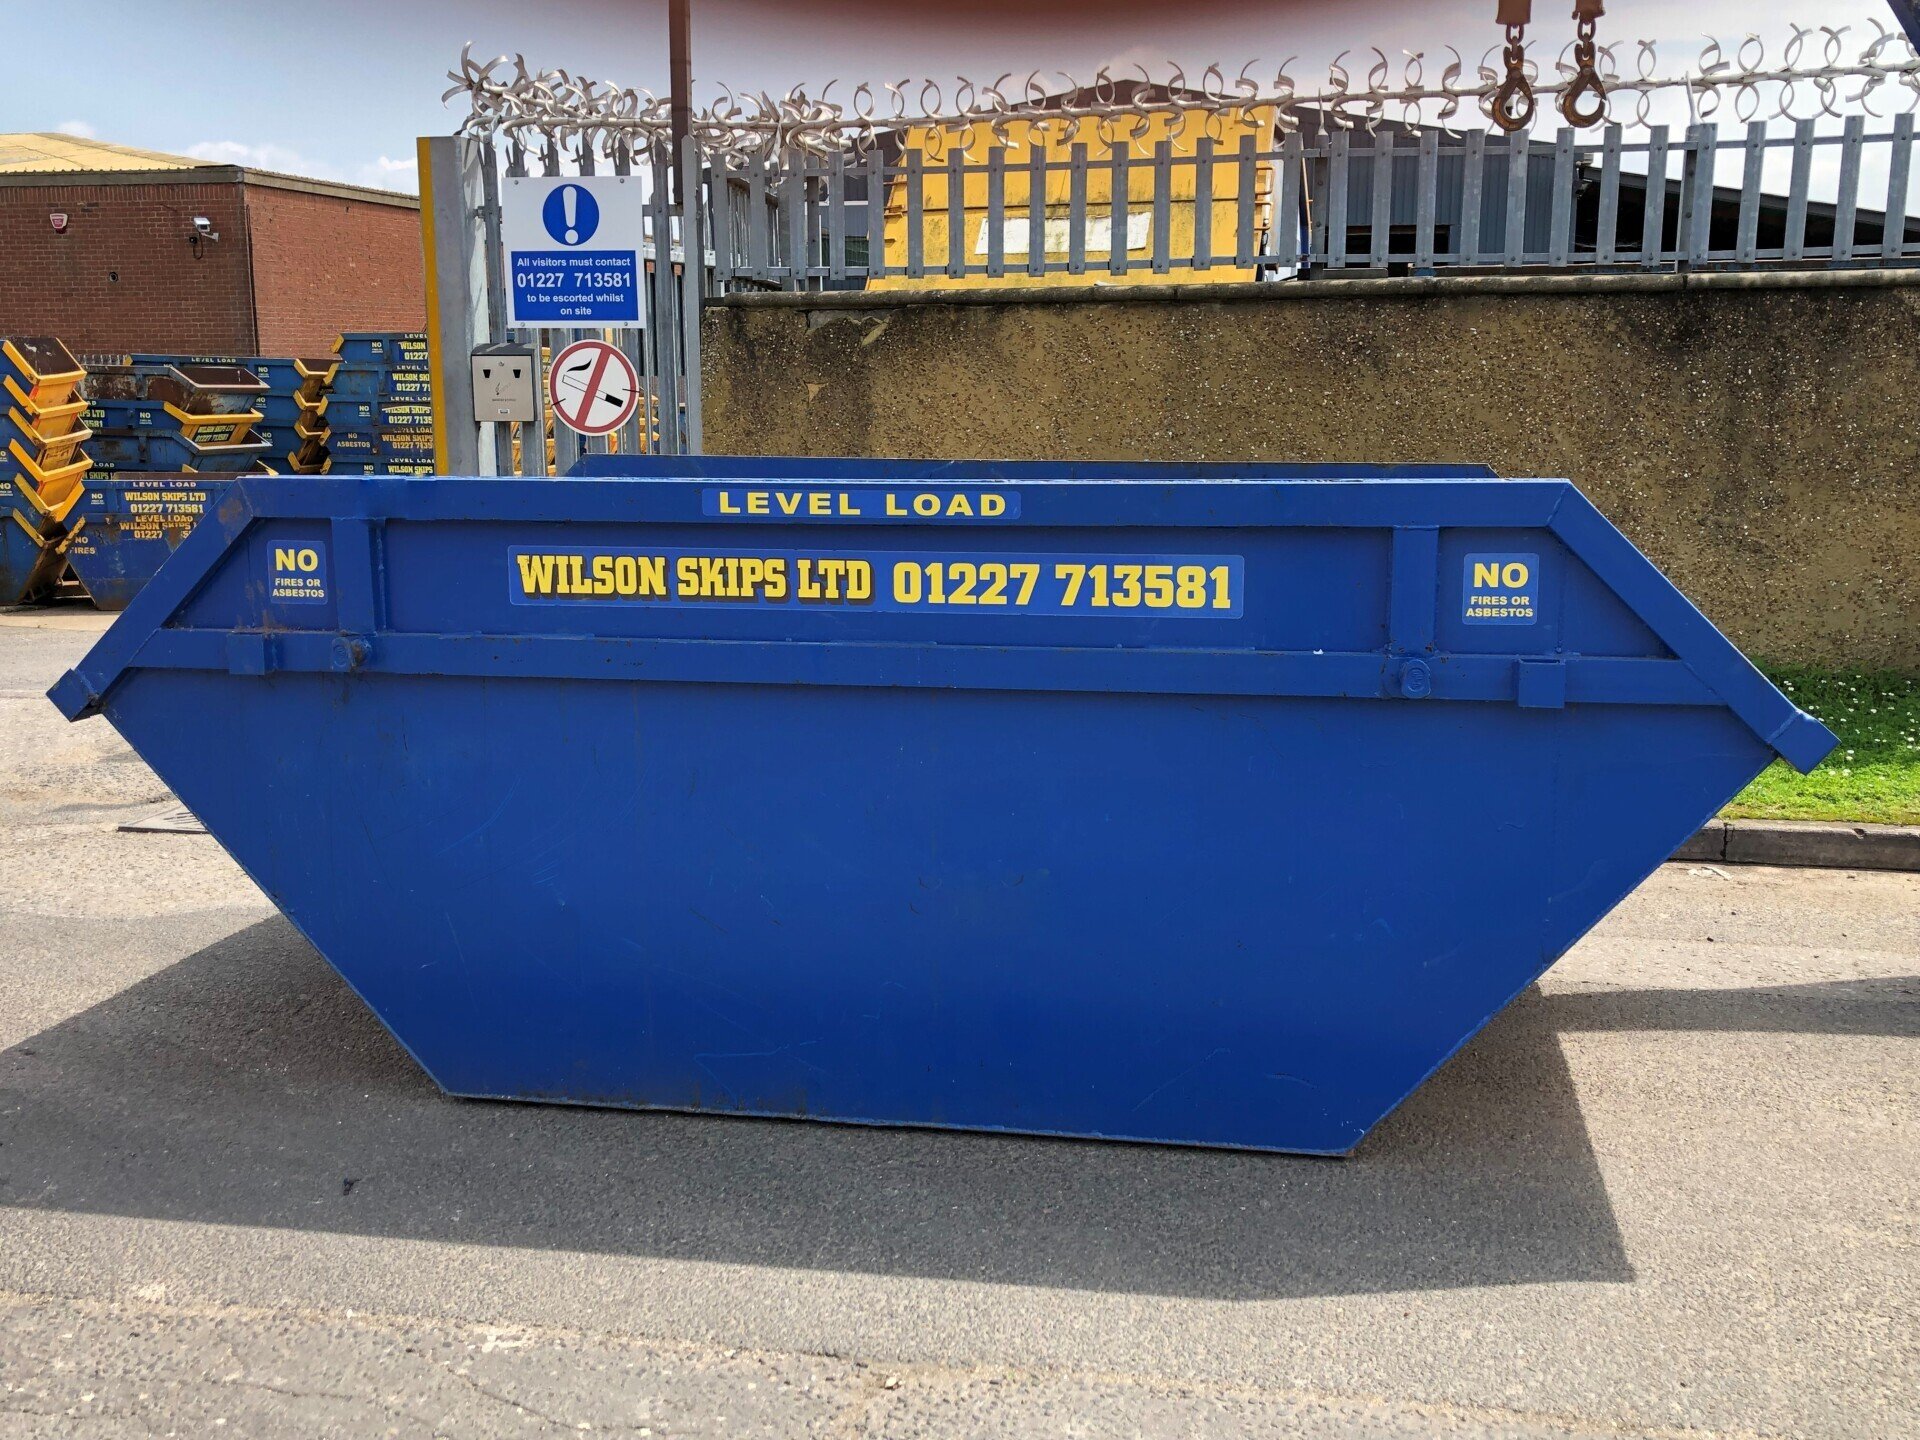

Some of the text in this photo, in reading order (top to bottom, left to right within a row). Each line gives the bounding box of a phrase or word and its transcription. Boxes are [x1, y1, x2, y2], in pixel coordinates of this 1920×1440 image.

[517, 258, 631, 266] All visitors must contact
[517, 273, 631, 288] 01227 713581
[527, 294, 624, 302] to be escorted whilst
[574, 307, 592, 315] site
[400, 341, 426, 350] WILSON
[404, 352, 428, 360] 01227
[392, 373, 430, 381] WILSON SKI
[396, 383, 420, 391] 01227
[92, 410, 105, 418] LTD
[84, 420, 103, 428] 3581
[389, 416, 432, 424] 01227 7135
[388, 465, 433, 474] WILSON SKIPS
[90, 471, 109, 480] SKIPS
[124, 492, 206, 501] WILSON SKIPS LTD
[130, 503, 204, 514] 01227 713581
[719, 492, 1007, 517] LEVEL LOAD
[119, 522, 160, 530] WILSON
[134, 530, 162, 539] 01227
[75, 536, 88, 544] NO
[275, 549, 318, 571] NO
[1474, 563, 1529, 588] NO
[275, 578, 321, 587] FIRES OR
[516, 555, 1231, 609] WILSON SKIPS LTD 01227 713581
[272, 588, 325, 598] ASBESTOS
[1470, 596, 1530, 605] FIRES OR
[1466, 608, 1534, 617] ASBESTOS
